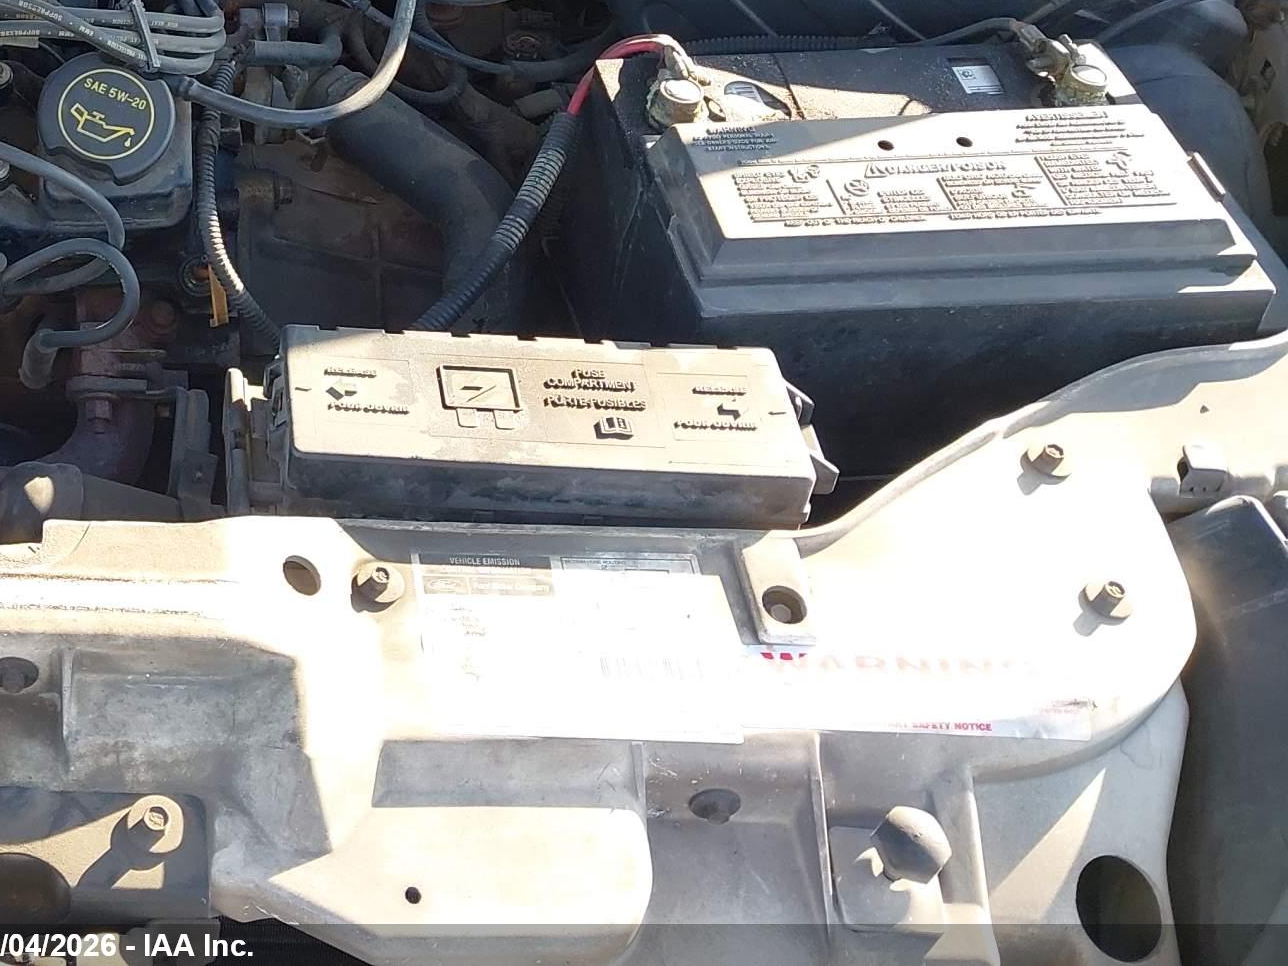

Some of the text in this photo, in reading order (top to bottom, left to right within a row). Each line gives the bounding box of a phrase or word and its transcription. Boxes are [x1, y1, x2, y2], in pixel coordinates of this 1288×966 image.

[84, 78, 147, 110] SAE 5W-20
[572, 368, 606, 379] FUSE
[544, 378, 638, 392] COMPARTMENT
[450, 557, 520, 566] VEHICLE EMISSION
[912, 721, 950, 731] SAFETY
[954, 722, 992, 732] NOTICE
